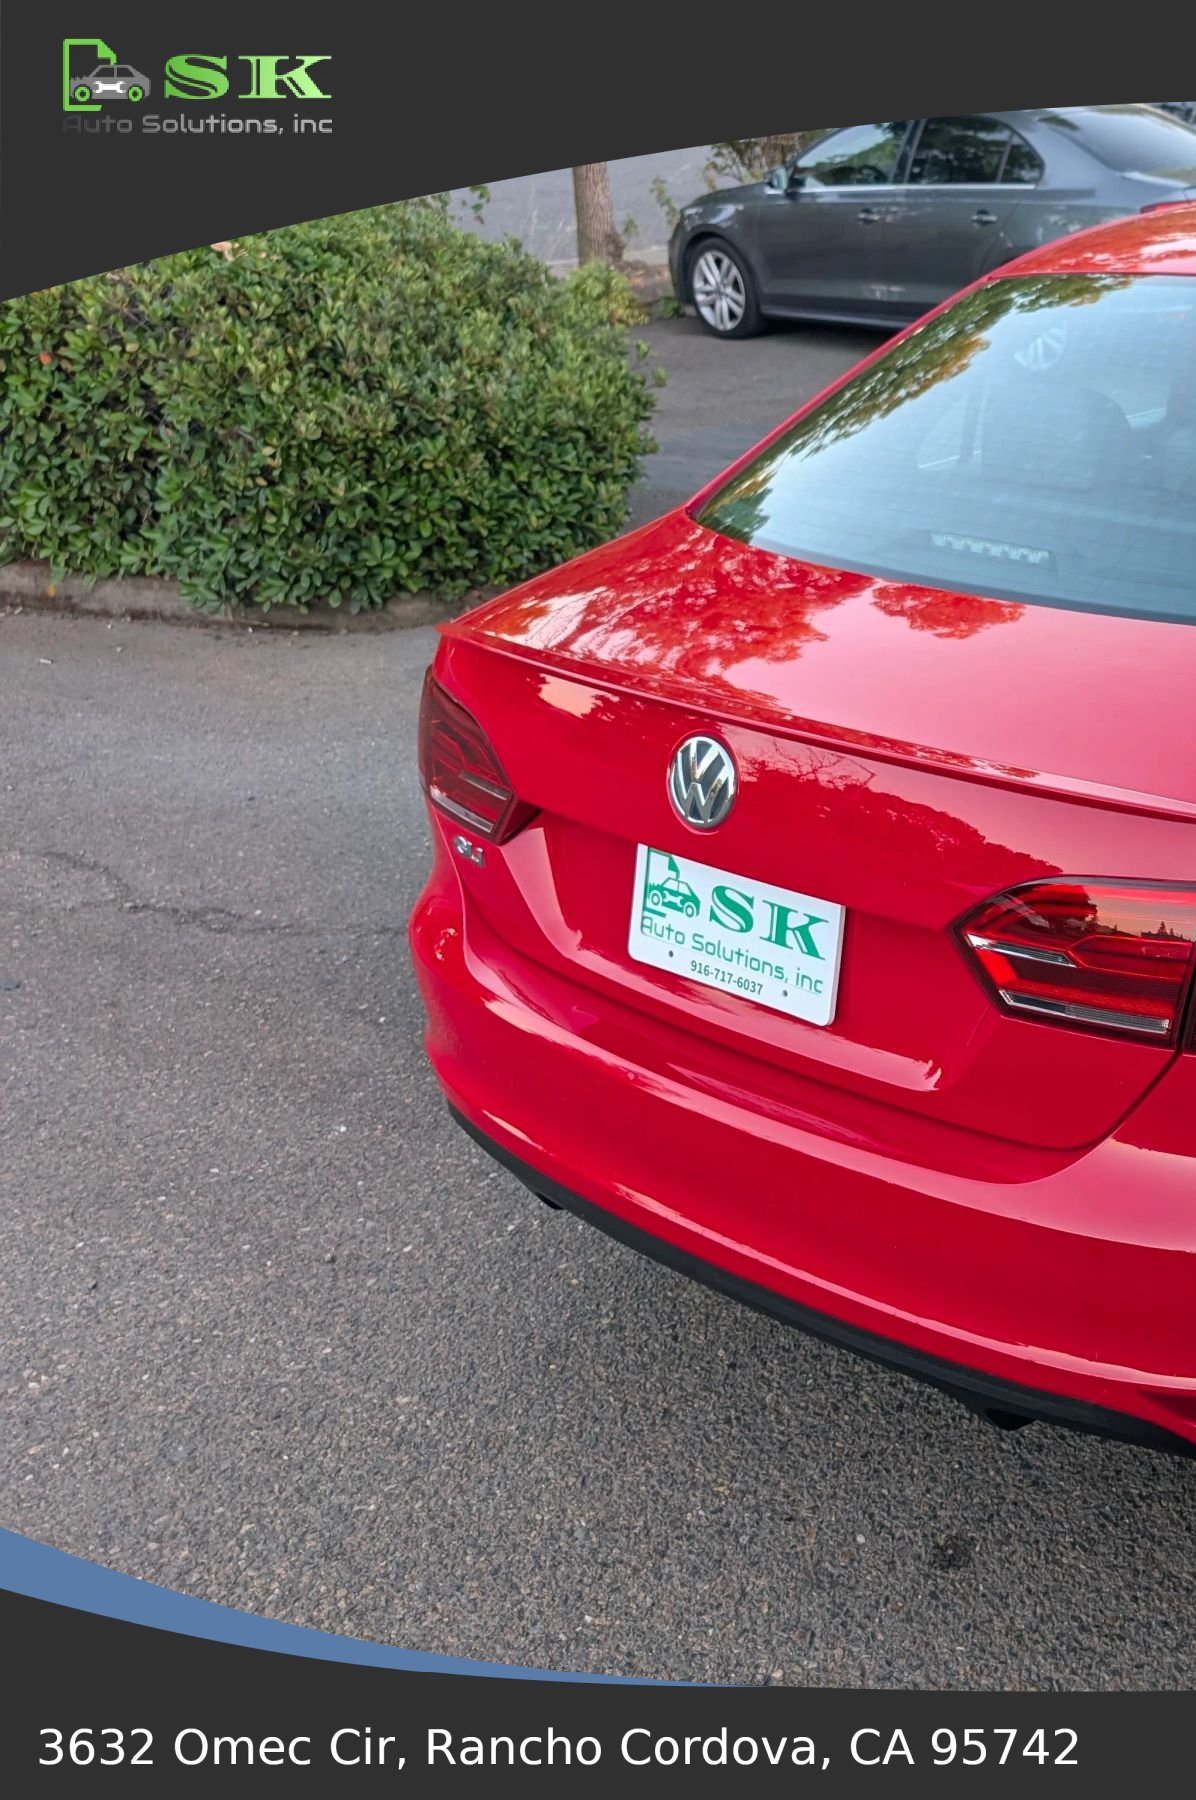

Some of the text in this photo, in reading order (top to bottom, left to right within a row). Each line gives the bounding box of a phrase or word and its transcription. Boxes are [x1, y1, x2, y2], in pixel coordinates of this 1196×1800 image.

[641, 915, 824, 994] Auto Solutions, inc
[709, 884, 829, 961] SK
[690, 959, 764, 996] 916-717-6037
